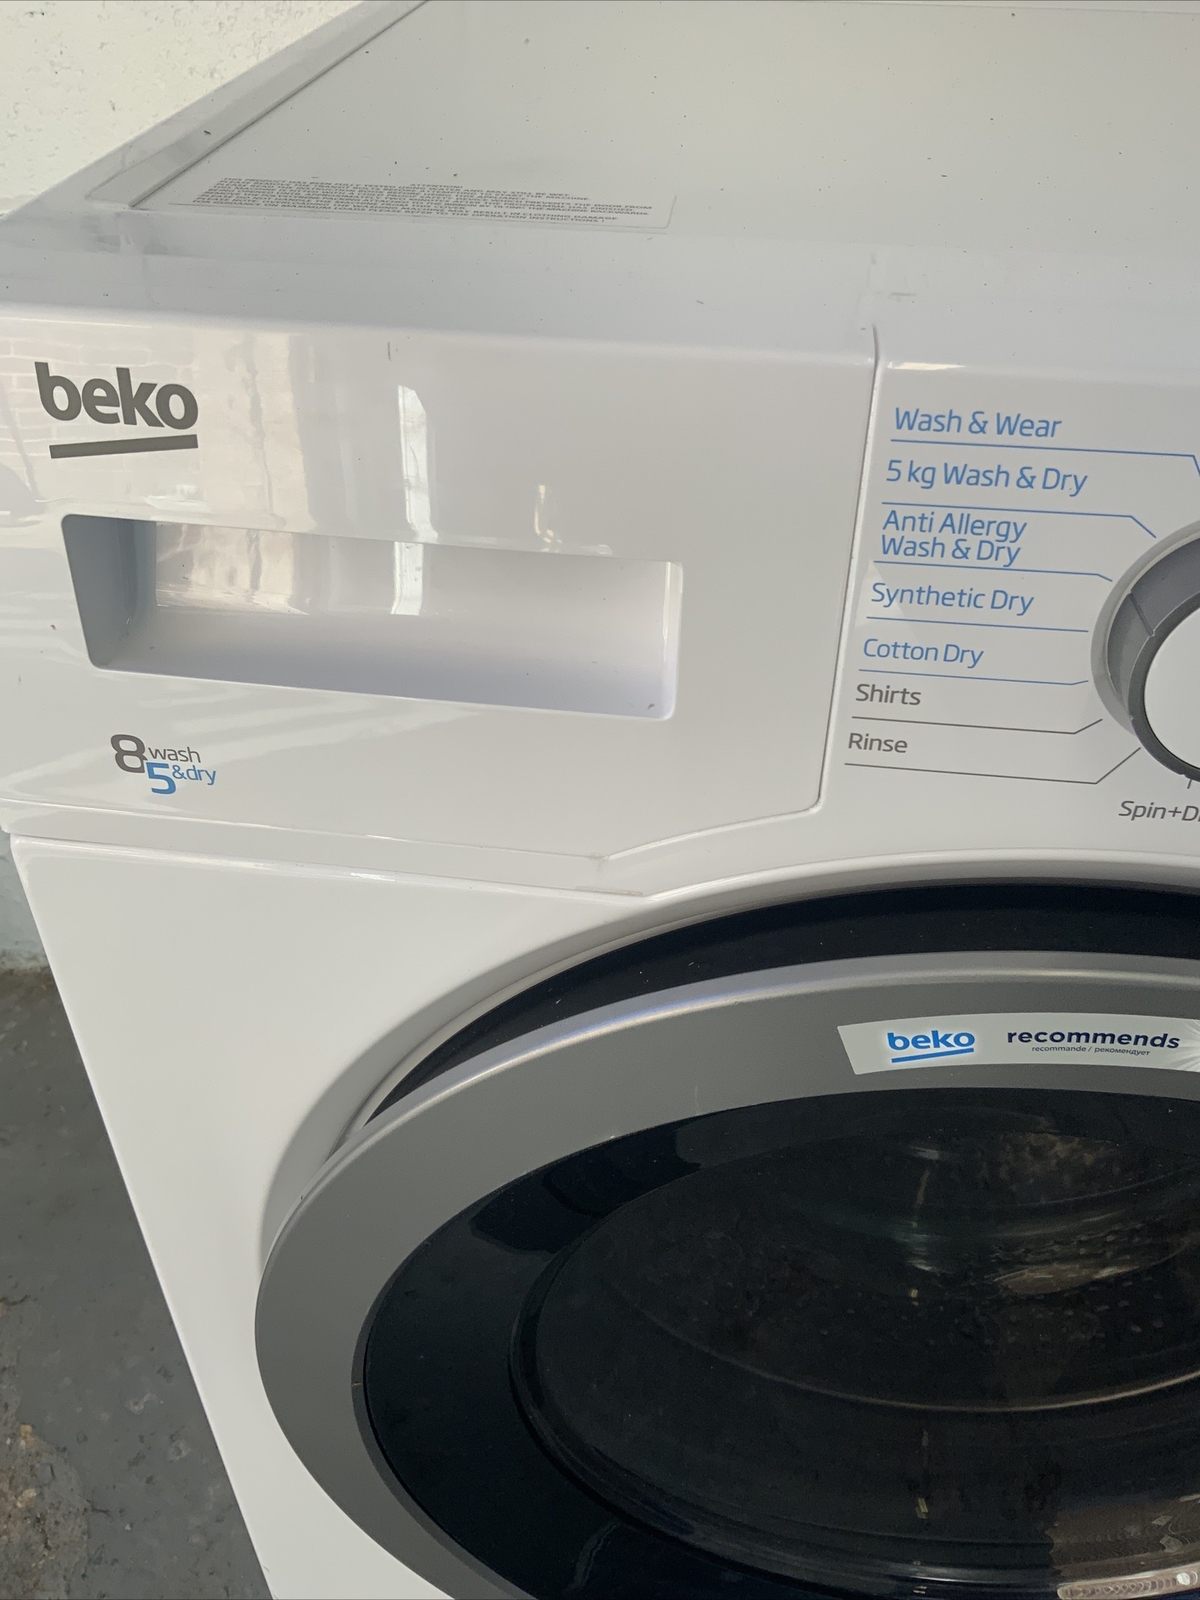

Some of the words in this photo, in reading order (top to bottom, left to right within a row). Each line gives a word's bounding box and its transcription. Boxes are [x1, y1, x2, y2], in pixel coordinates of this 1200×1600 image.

[34, 361, 198, 430] beko
[895, 407, 962, 433] Wash
[967, 411, 989, 434] &
[996, 412, 1062, 437] Wear
[886, 459, 902, 482] 5
[907, 460, 936, 489] kg
[943, 462, 1010, 487] Wash
[1015, 466, 1036, 489] &
[1042, 467, 1088, 497] Dry
[882, 510, 935, 533] Anti
[938, 512, 1027, 543] Allergy
[881, 534, 946, 558] Wash
[951, 538, 972, 559] &
[976, 539, 1021, 567] Dry
[871, 582, 986, 609] Synthetic
[990, 589, 1035, 616] Dry
[863, 638, 939, 661] Cotton
[943, 643, 984, 669] Dry
[855, 683, 922, 706] Shirts
[110, 733, 148, 774] 8
[148, 746, 202, 763] wash
[848, 732, 908, 753] Rinse
[145, 761, 177, 795] 5
[1118, 800, 1200, 822] Spin+D
[887, 1030, 975, 1050] beko
[1007, 1031, 1180, 1050] recommends
